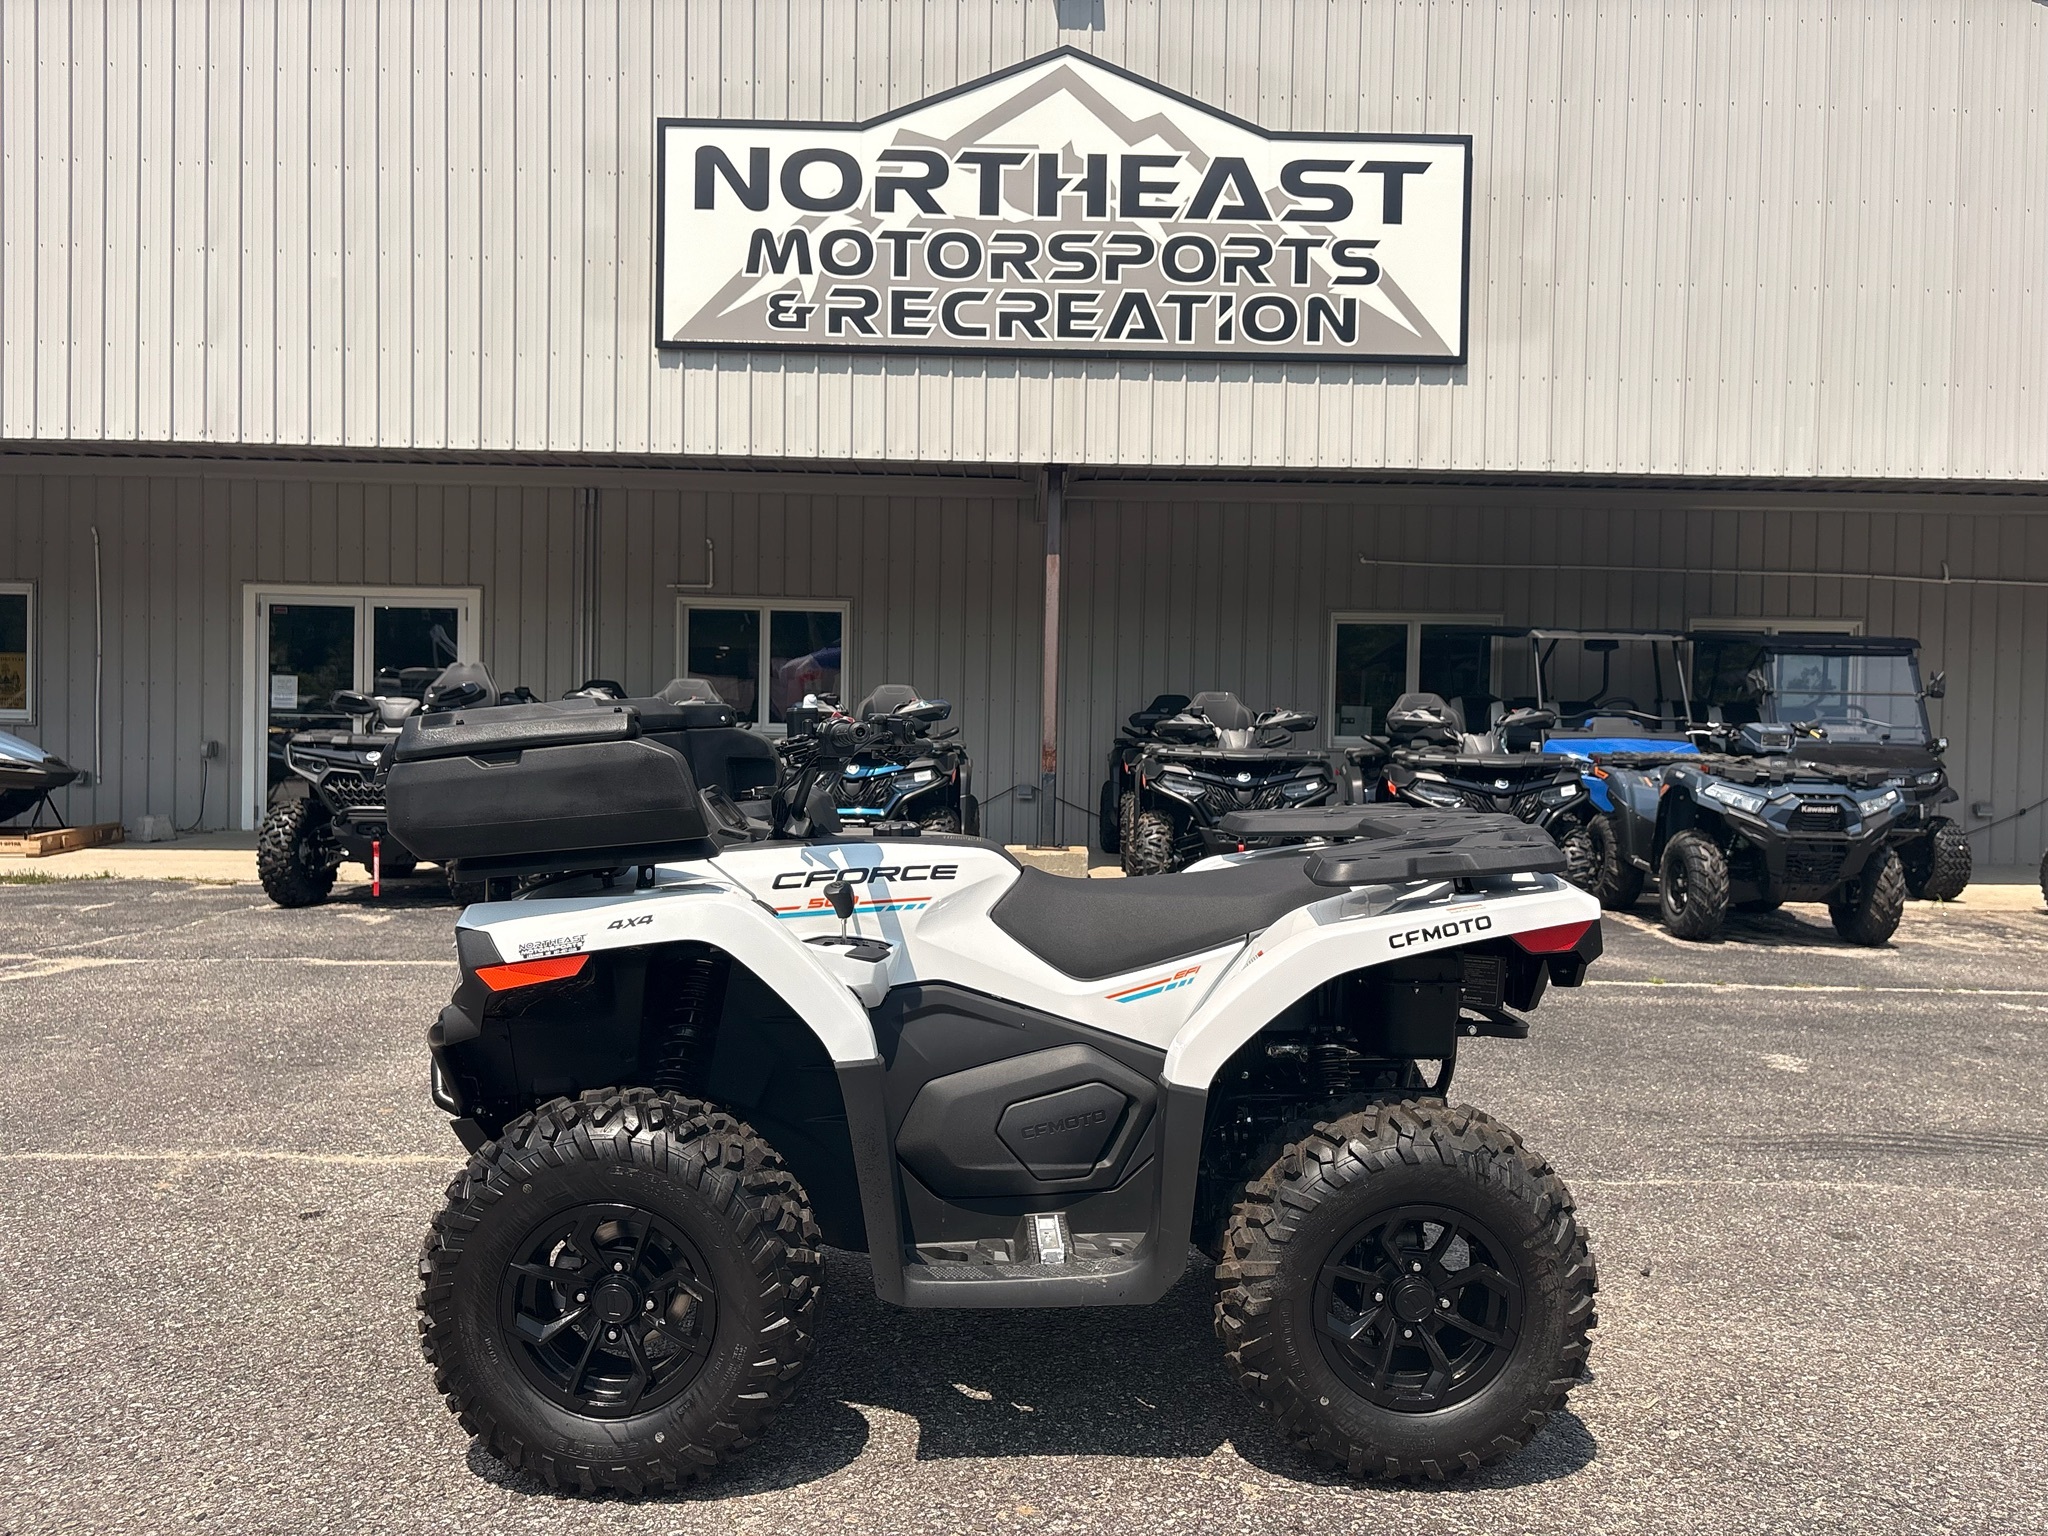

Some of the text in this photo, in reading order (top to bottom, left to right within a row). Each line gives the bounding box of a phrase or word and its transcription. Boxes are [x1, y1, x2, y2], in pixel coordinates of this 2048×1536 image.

[694, 146, 1431, 225] NORTHEAST
[746, 228, 1380, 285] MOTORSPORTS
[1801, 804, 1838, 814] Kawasaki
[772, 864, 959, 890] CFORCE
[518, 933, 588, 950] NORTHEAST
[1388, 915, 1493, 949] CFMOTO
[1173, 965, 1201, 980] EFI
[1021, 1109, 1107, 1140] CFMOTO
